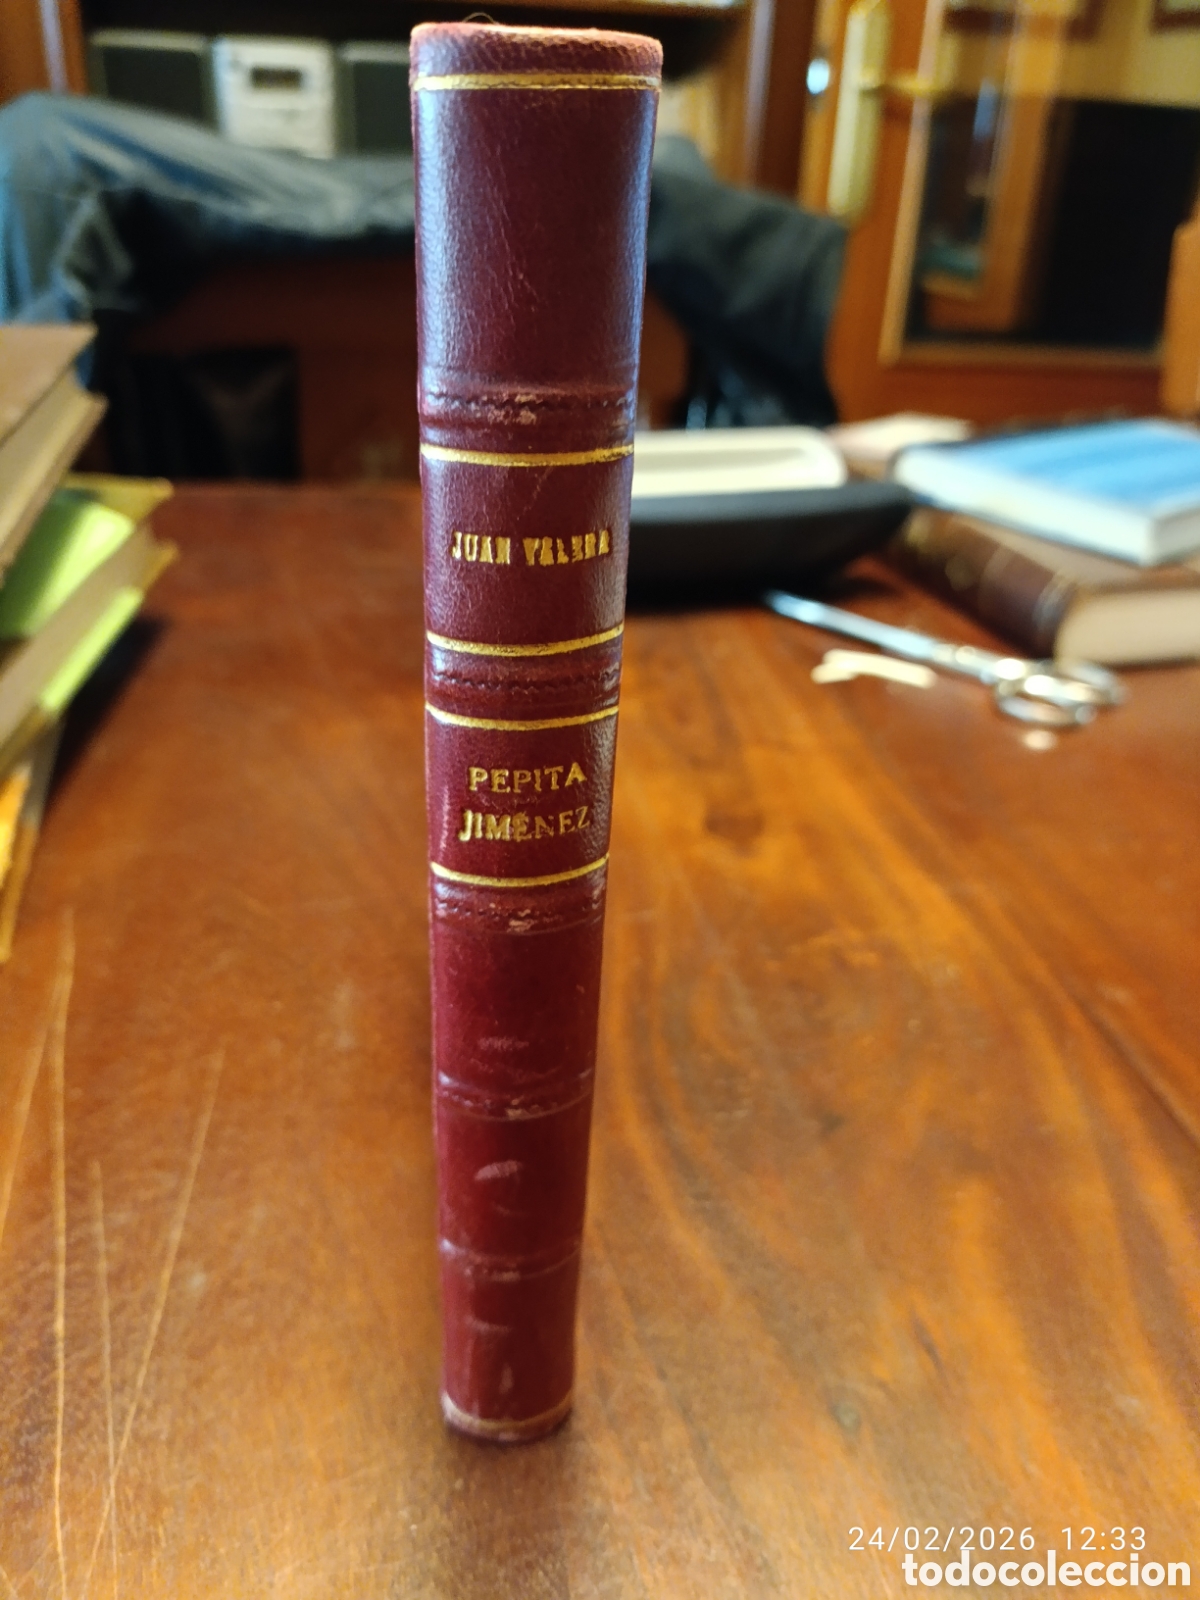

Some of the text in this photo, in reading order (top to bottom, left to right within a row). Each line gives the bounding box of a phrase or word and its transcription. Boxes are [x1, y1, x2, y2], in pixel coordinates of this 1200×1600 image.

[452, 530, 610, 566] JUAN VALERA
[468, 762, 587, 793] PEPITA
